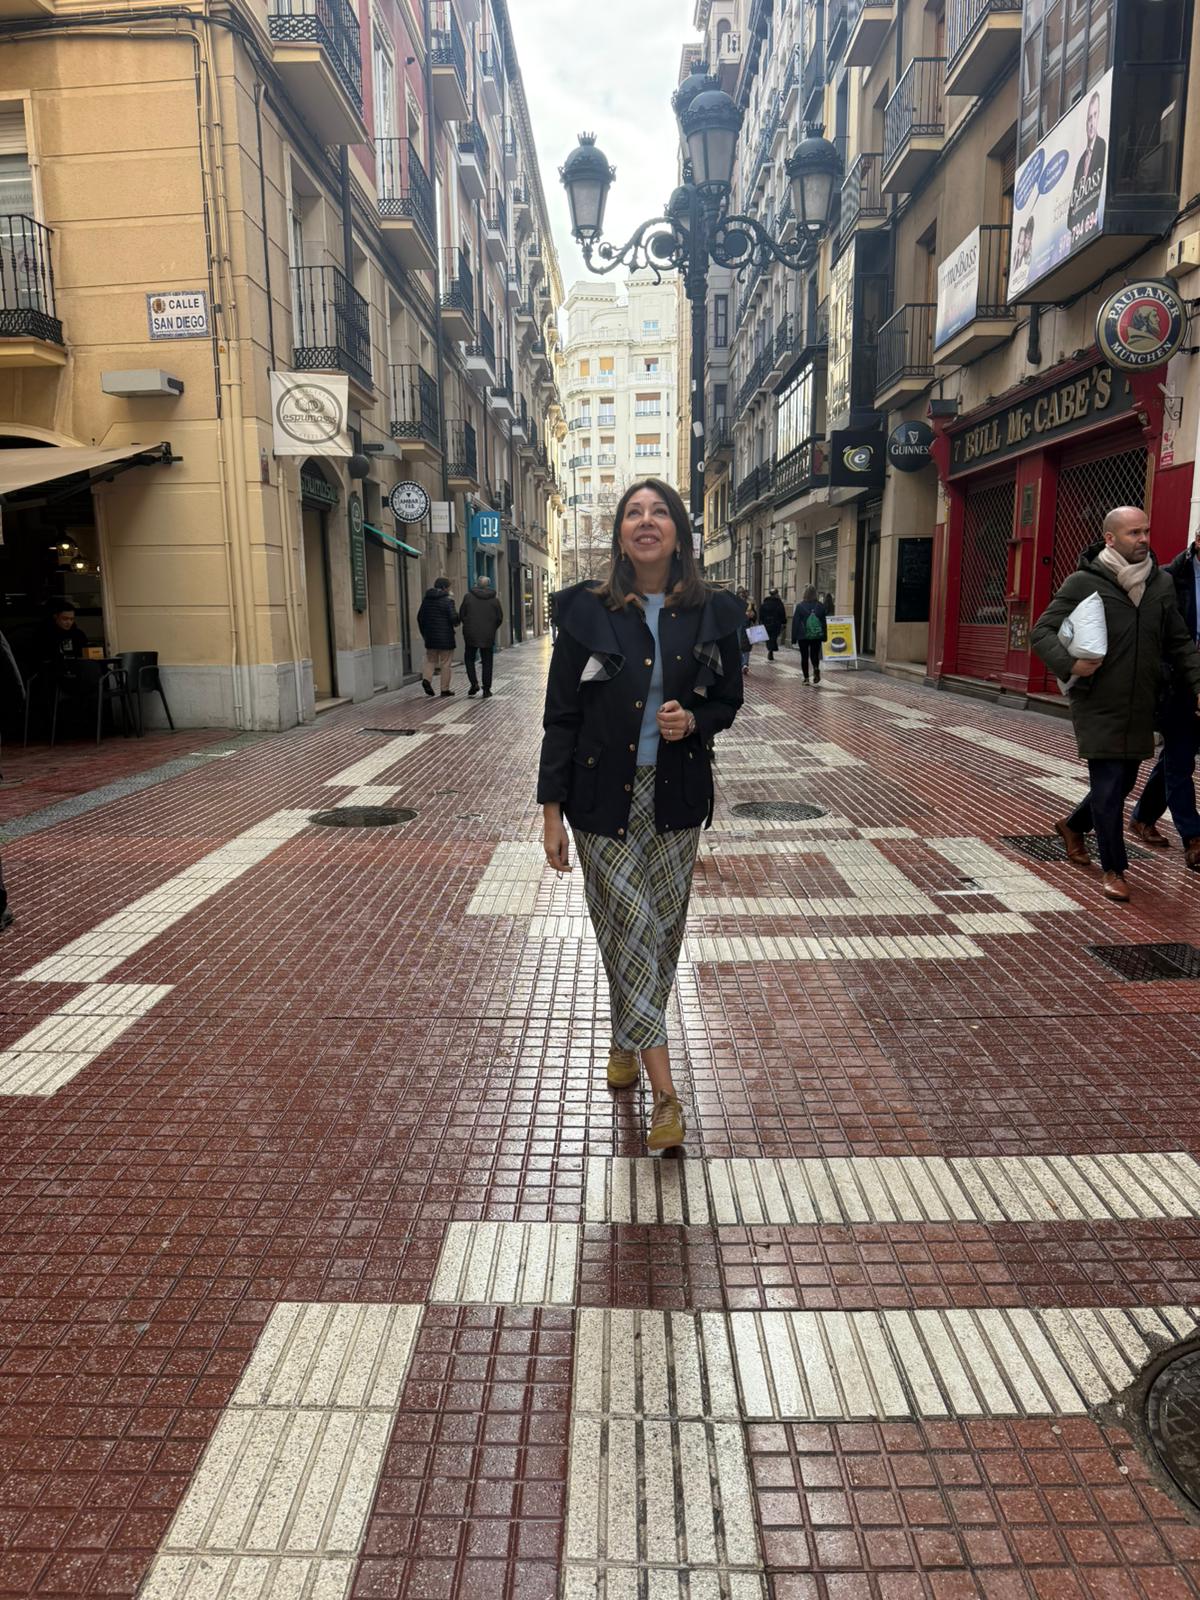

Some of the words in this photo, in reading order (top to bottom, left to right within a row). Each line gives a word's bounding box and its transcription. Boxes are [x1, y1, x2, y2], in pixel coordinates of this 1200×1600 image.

[168, 298, 200, 310] CALLE
[1108, 287, 1180, 319] PAULANER
[153, 317, 174, 330] SAN
[176, 315, 205, 329] DIEGO
[964, 420, 1001, 462] BULL
[891, 444, 929, 455] GUINNES
